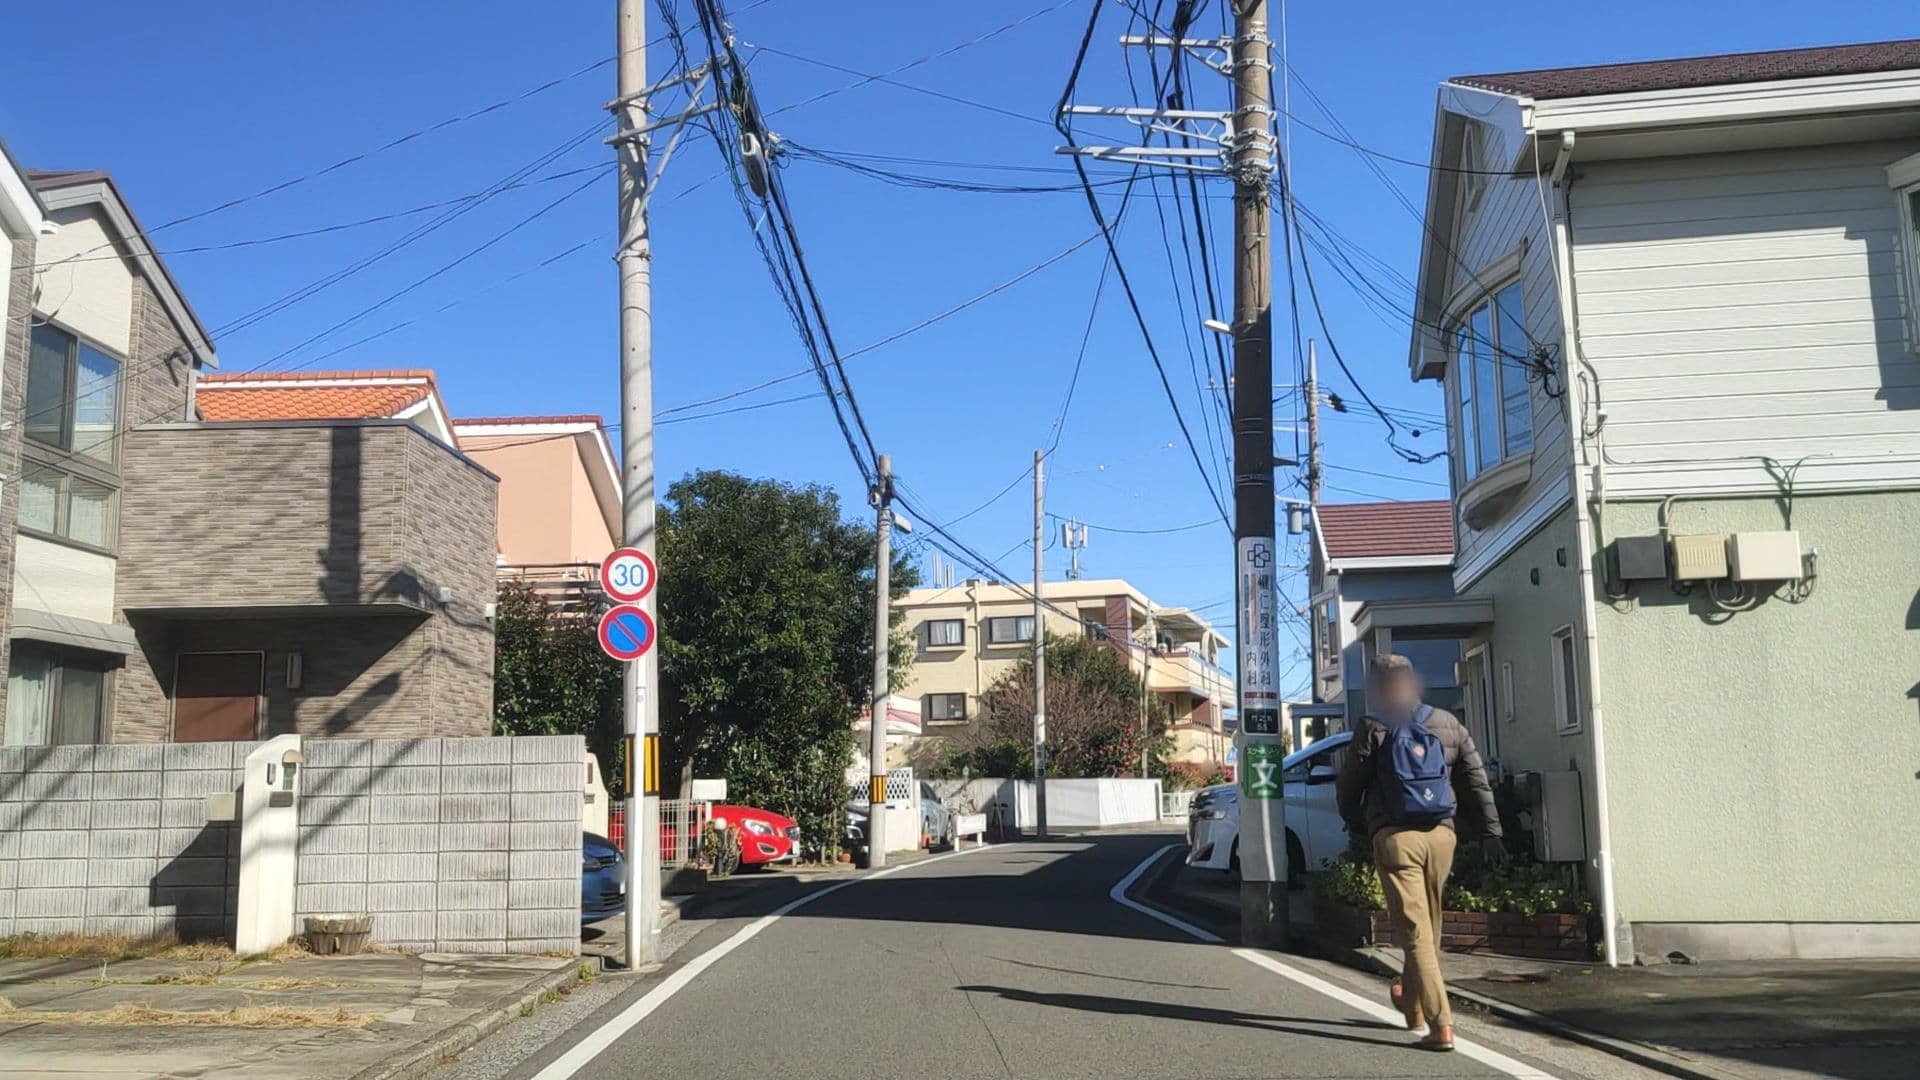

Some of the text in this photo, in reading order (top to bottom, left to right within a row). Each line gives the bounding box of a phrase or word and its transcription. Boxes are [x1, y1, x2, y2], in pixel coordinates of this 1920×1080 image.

[615, 564, 644, 587] 30
[1246, 652, 1257, 686] 内科
[1251, 757, 1278, 787] 文
